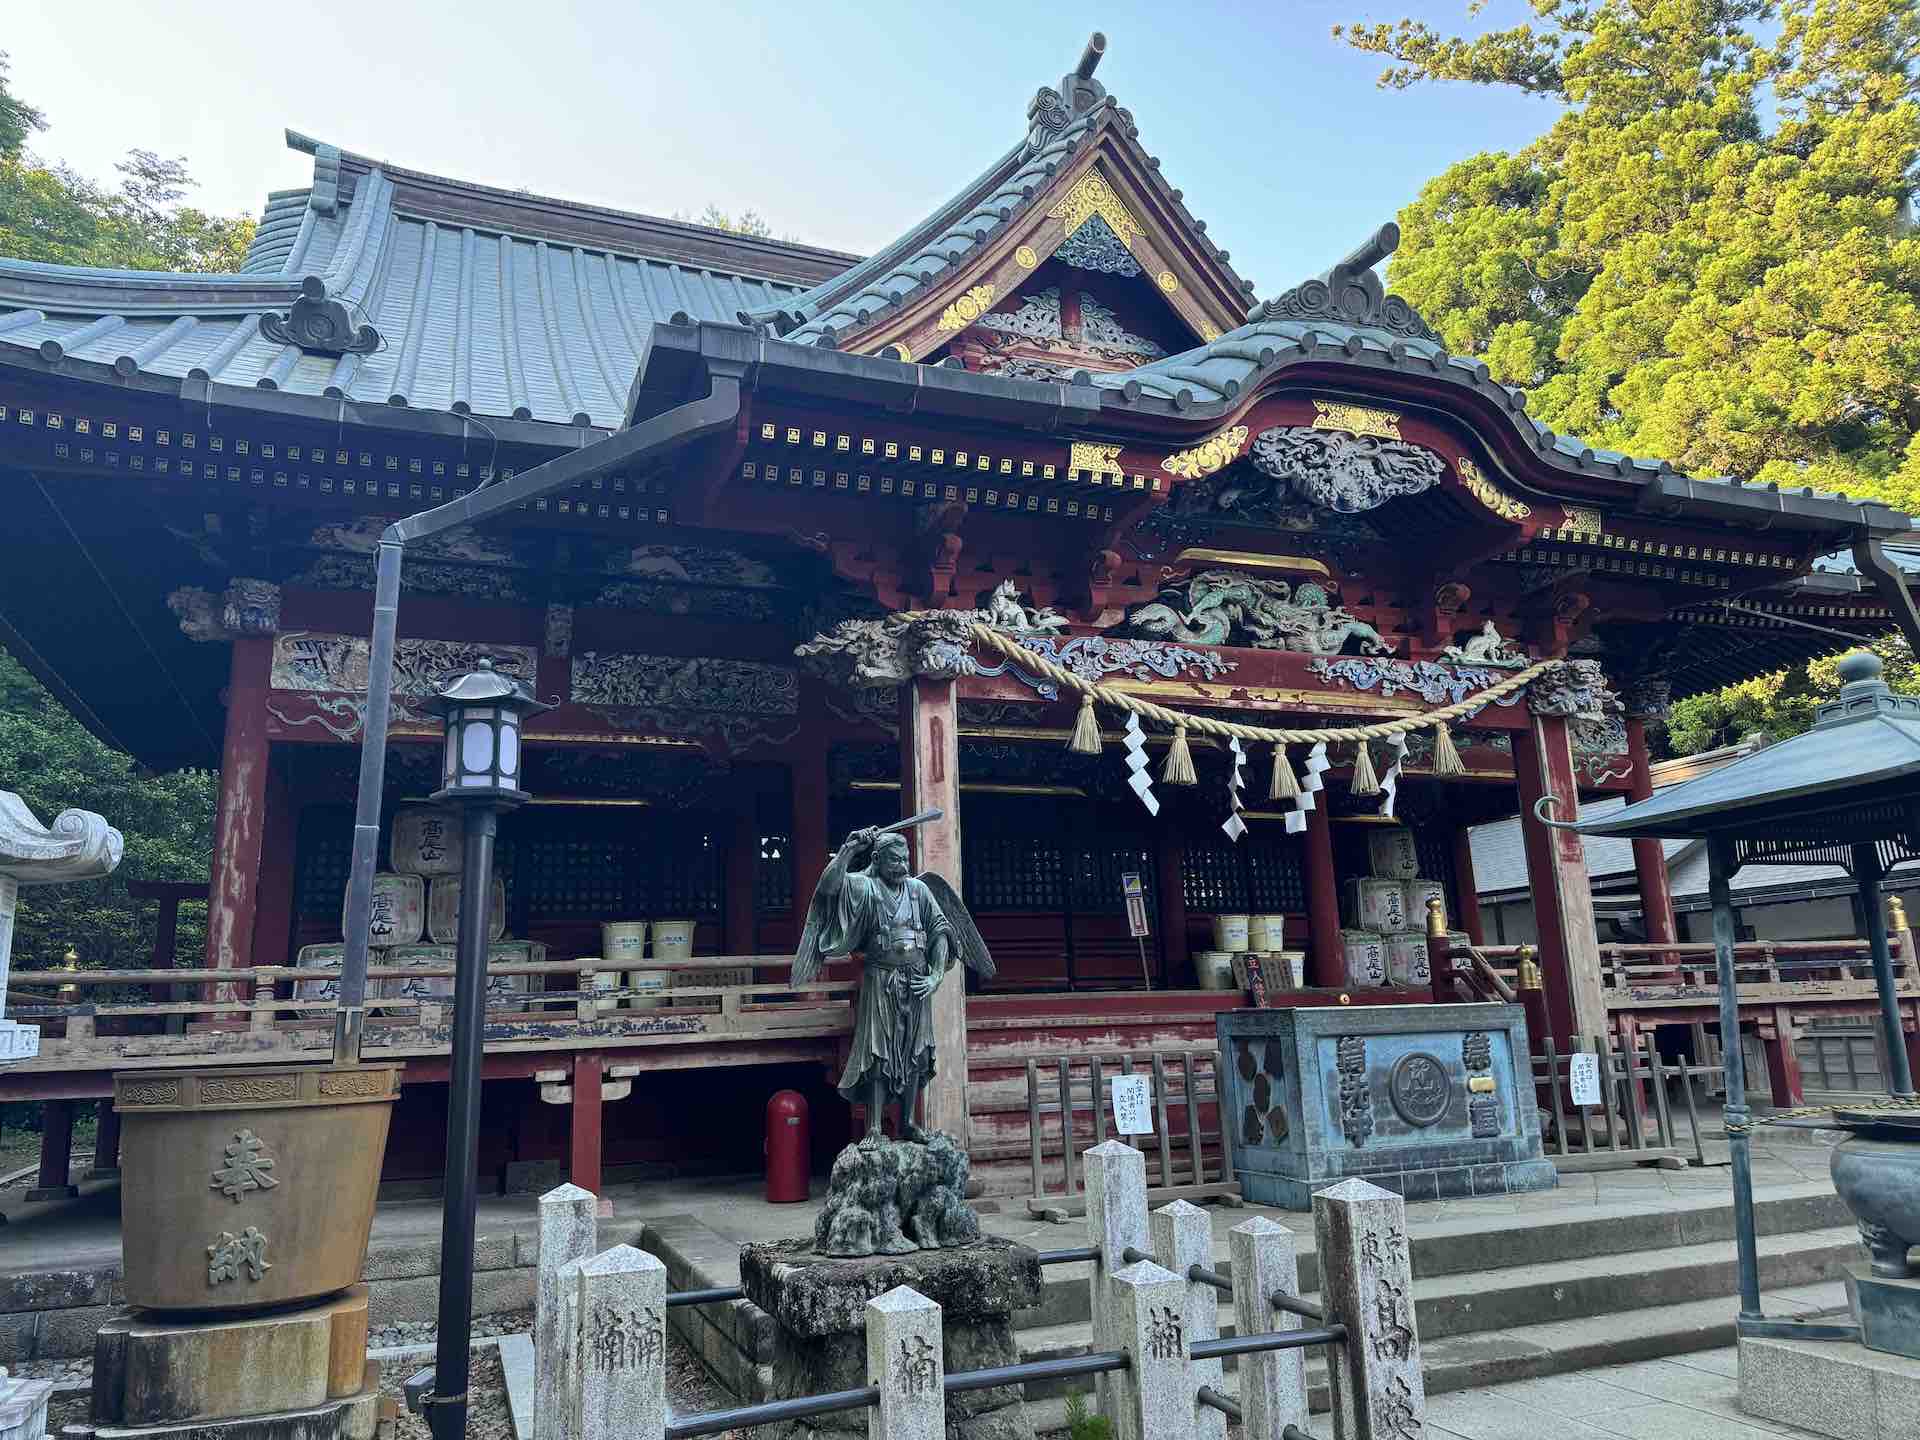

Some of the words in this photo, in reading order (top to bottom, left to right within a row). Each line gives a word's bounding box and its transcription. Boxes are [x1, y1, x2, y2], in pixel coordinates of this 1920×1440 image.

[419, 818, 446, 863] 高尾山
[369, 891, 396, 937] 高尾山
[1386, 891, 1403, 926] 高尾山
[1365, 944, 1384, 980] 高尾山
[1413, 943, 1430, 979] 高尾山
[207, 1128, 281, 1286] 奉納
[1360, 1227, 1405, 1267] 東京
